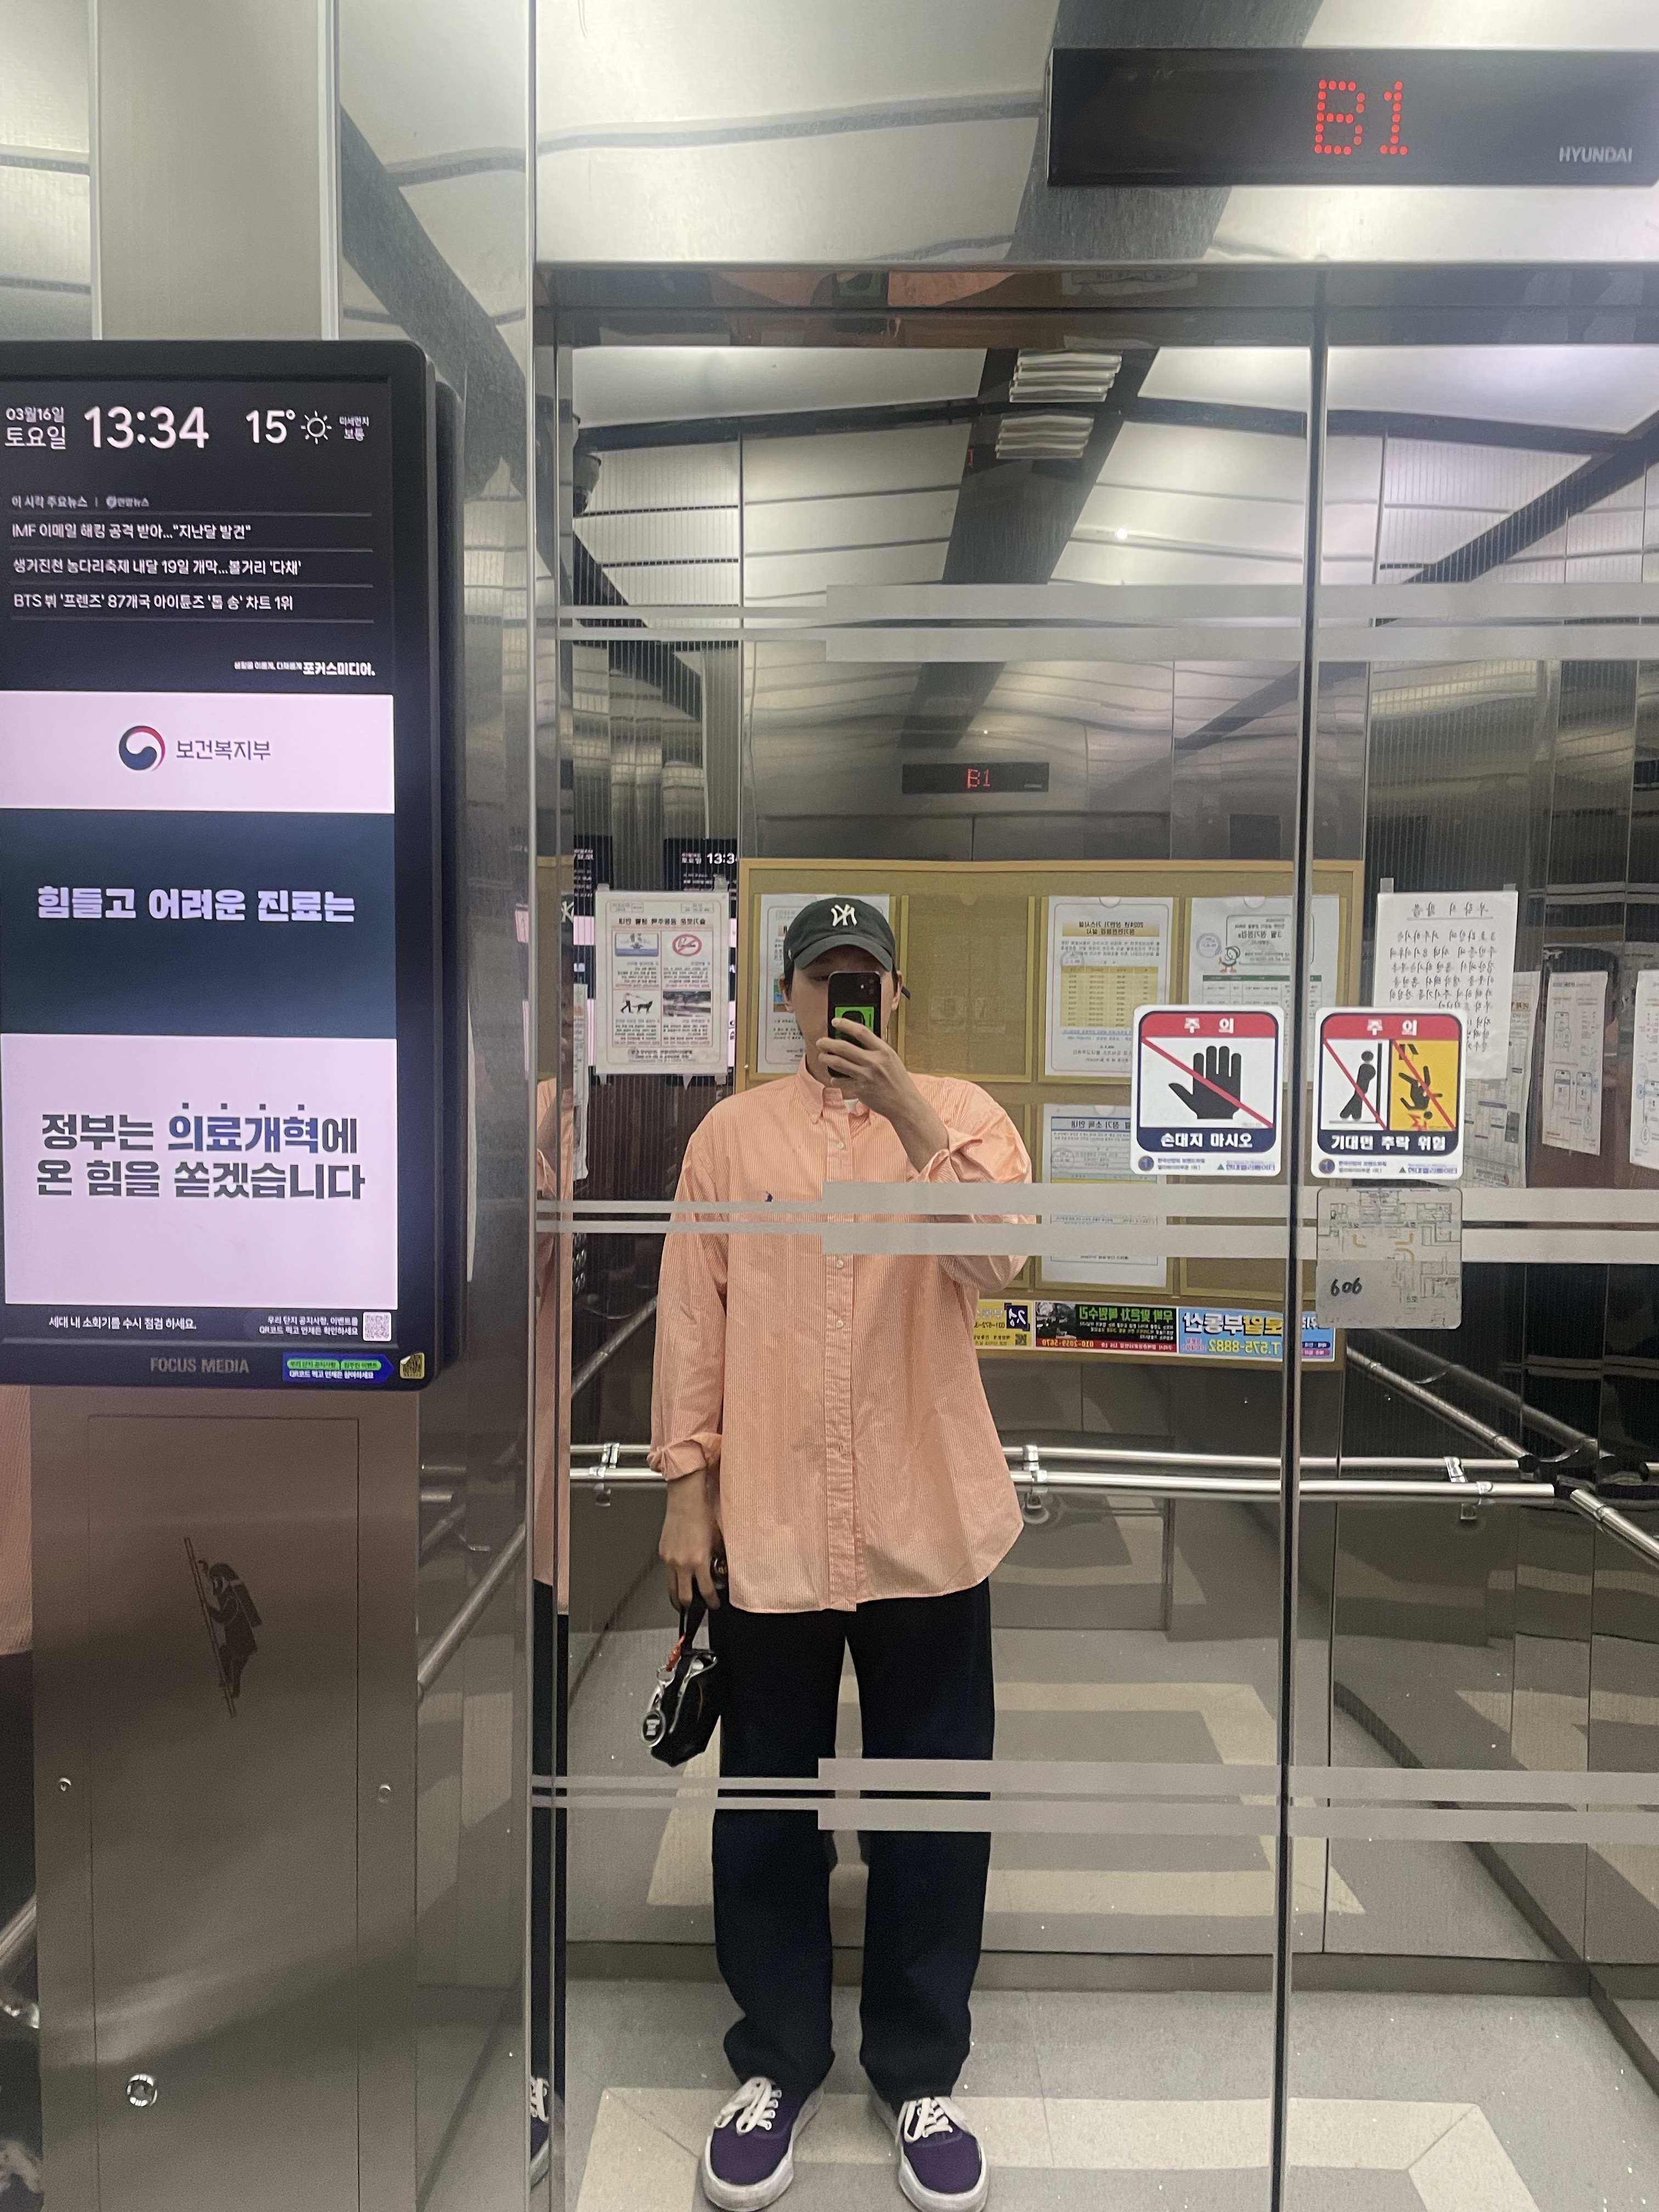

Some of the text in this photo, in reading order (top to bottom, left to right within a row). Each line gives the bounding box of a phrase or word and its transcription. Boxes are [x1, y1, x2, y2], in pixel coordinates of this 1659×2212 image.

[1314, 79, 1408, 156] B1
[1559, 146, 1633, 163] HYUNDAI
[5, 406, 64, 424] 03월16일
[84, 405, 209, 449] 13:34
[4, 425, 66, 450] 토요일
[12, 523, 37, 538] IMF
[39, 523, 77, 538] 이메일
[81, 523, 105, 539] 해킹
[109, 523, 134, 539] 공격
[133, 559, 158, 574] 내달
[161, 559, 189, 575] 19일
[13, 594, 42, 607] BTS
[108, 594, 151, 609] 87개국
[154, 594, 205, 610] 아이튠즈
[245, 595, 272, 610] 차트
[274, 595, 293, 611] 1위
[176, 740, 272, 760] 보건복지부
[967, 768, 990, 788] B1
[37, 885, 356, 922] 힘들고 어려운 진료는
[42, 1113, 358, 1154] 정부는 의료개혁에
[1160, 1132, 1253, 1149] 손대지 마시오
[1331, 1135, 1446, 1151] 기대면 추락 위험
[36, 1159, 366, 1200] 온 힘을 쏟겠습니다
[1330, 1277, 1362, 1297] 606
[49, 1316, 69, 1328] 세대
[70, 1316, 81, 1328] 내
[82, 1316, 121, 1329] 소화기를
[122, 1317, 142, 1329] 수시
[144, 1317, 163, 1330] 점검
[268, 1315, 281, 1325] 우리
[283, 1316, 297, 1325] 단지
[150, 1356, 250, 1374] FOCUS MEDIA
